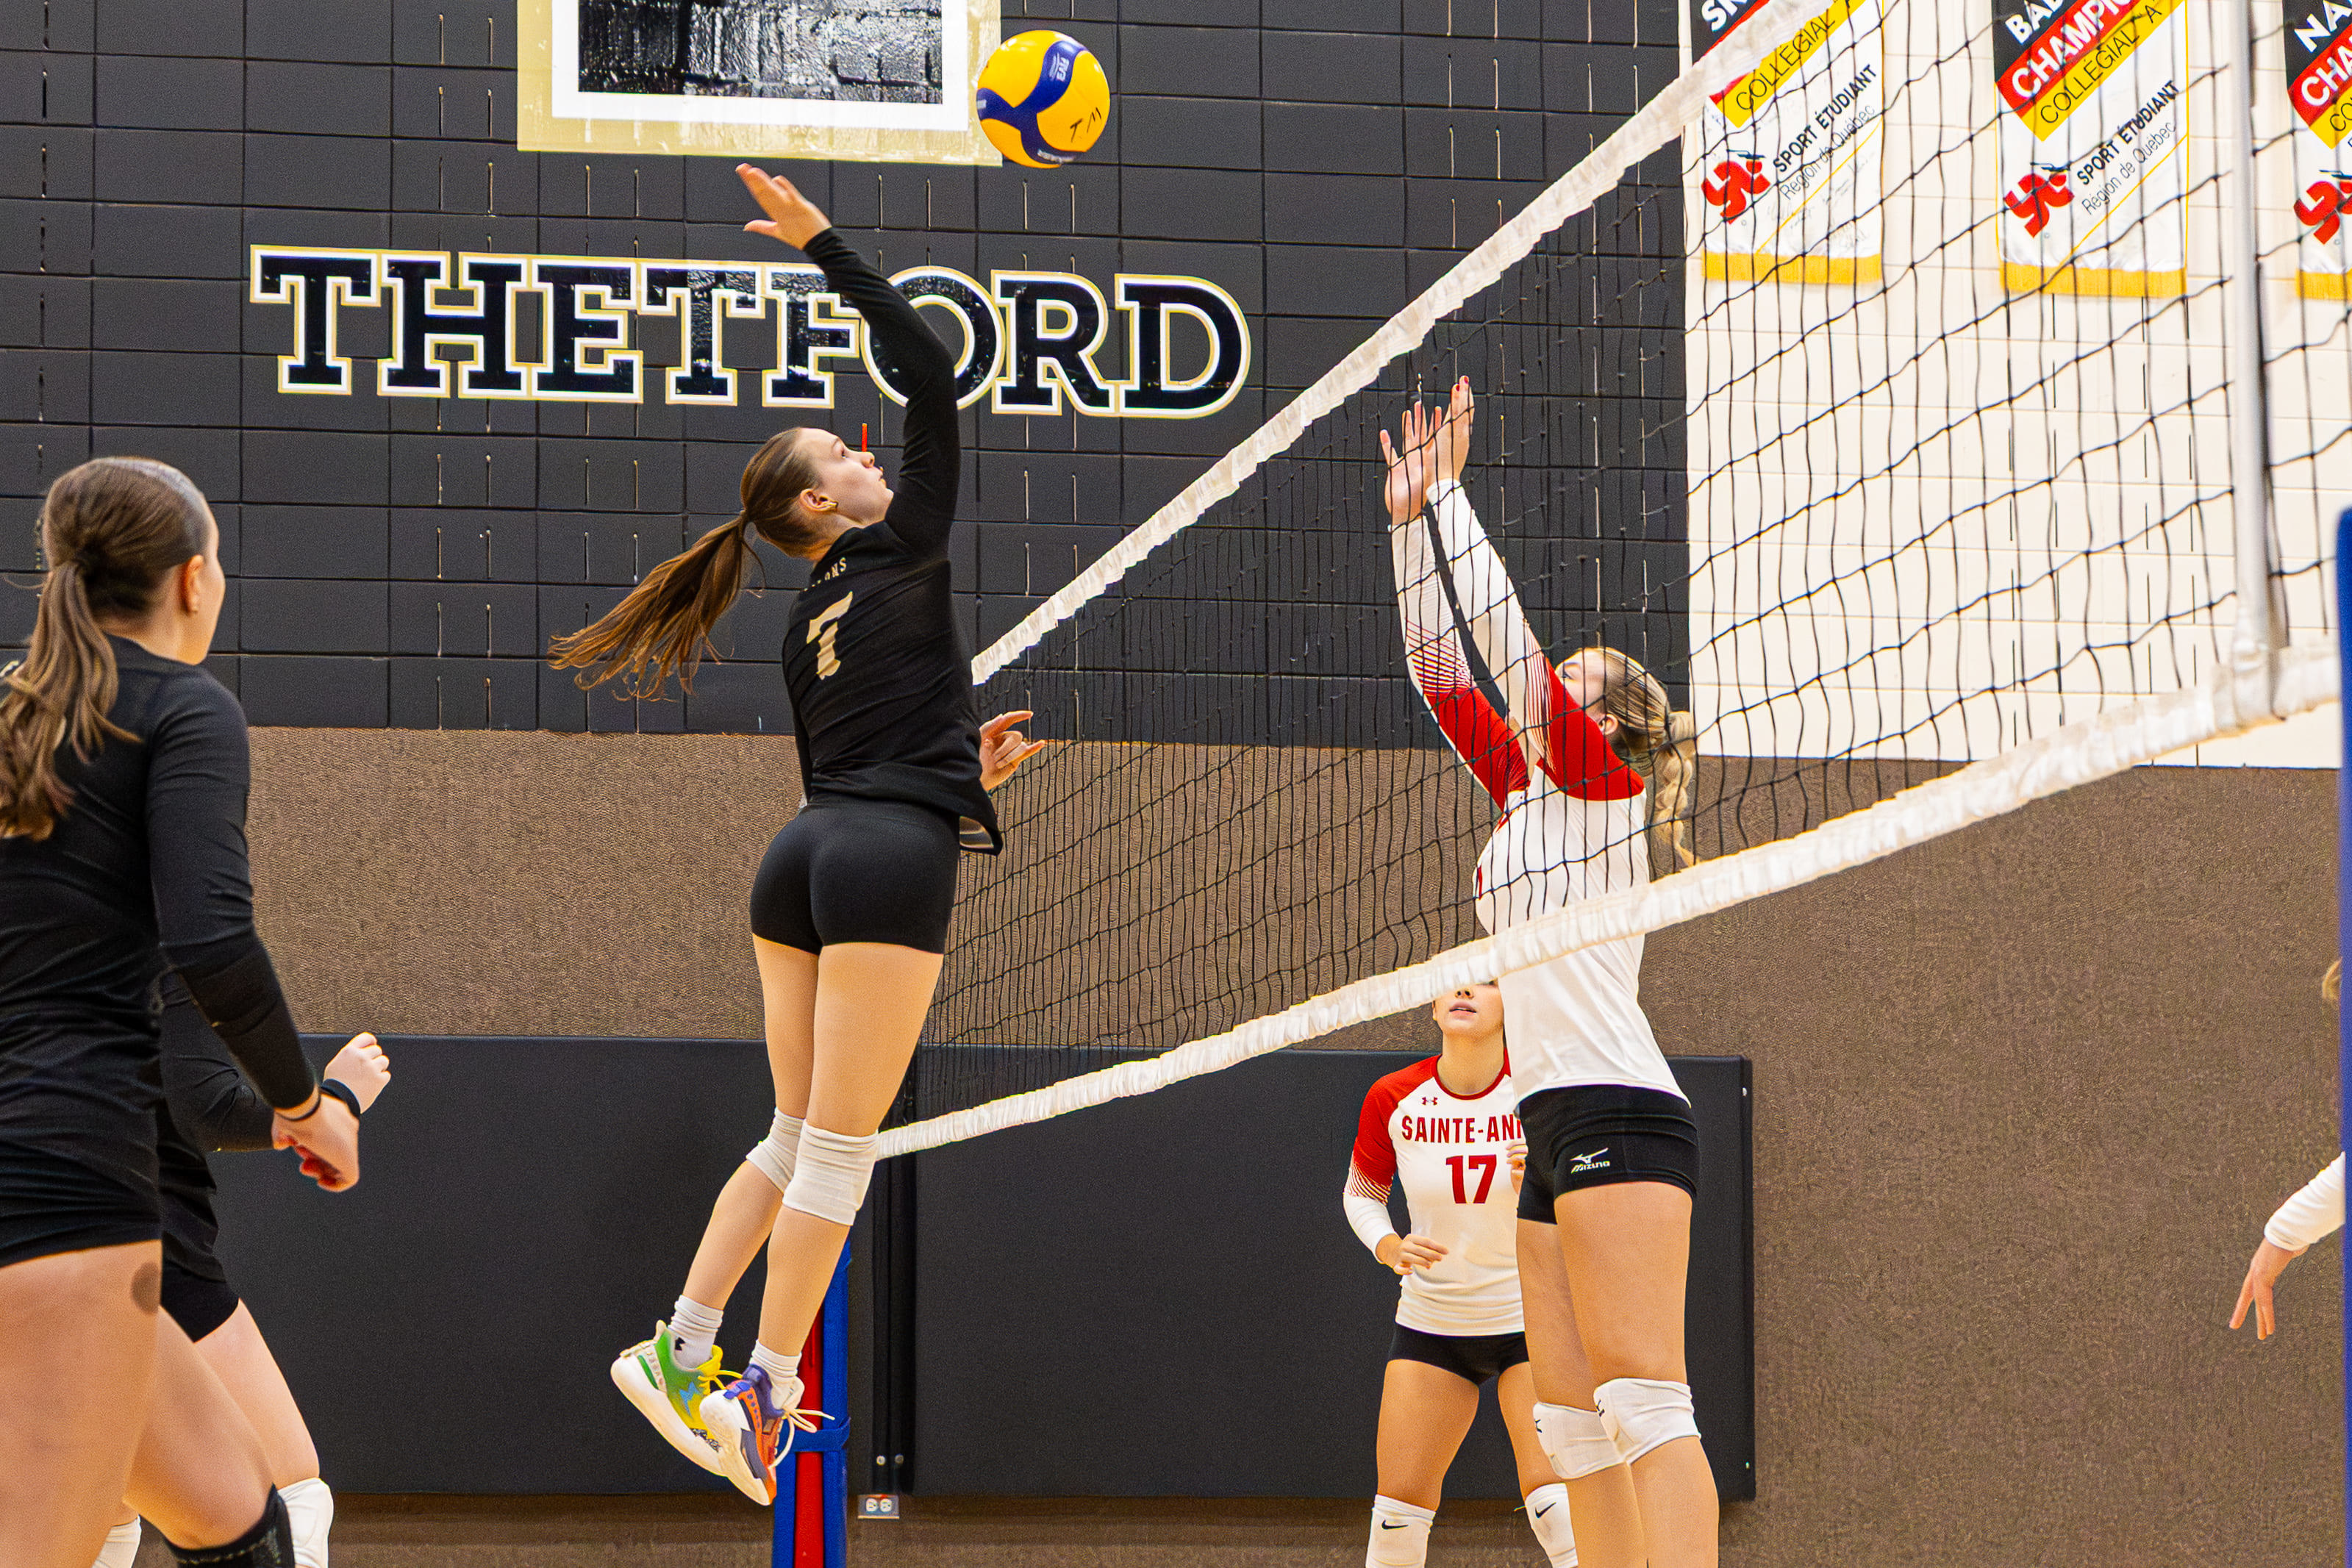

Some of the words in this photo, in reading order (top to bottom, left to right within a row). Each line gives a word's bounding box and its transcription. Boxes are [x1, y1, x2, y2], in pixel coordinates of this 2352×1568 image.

[1773, 124, 1817, 172] SPORT
[1815, 64, 1876, 129] ÉTUDIANT
[2040, 29, 2140, 123] COLLÉGIAL
[2076, 139, 2120, 185] SPORT
[2117, 79, 2179, 144] ÉTUDIANT
[2081, 176, 2122, 215] Région
[2120, 162, 2135, 179] de
[2132, 122, 2176, 164] Québec
[251, 244, 1251, 418] THETFORD
[807, 590, 854, 681] 7
[1445, 1153, 1497, 1204] 17
